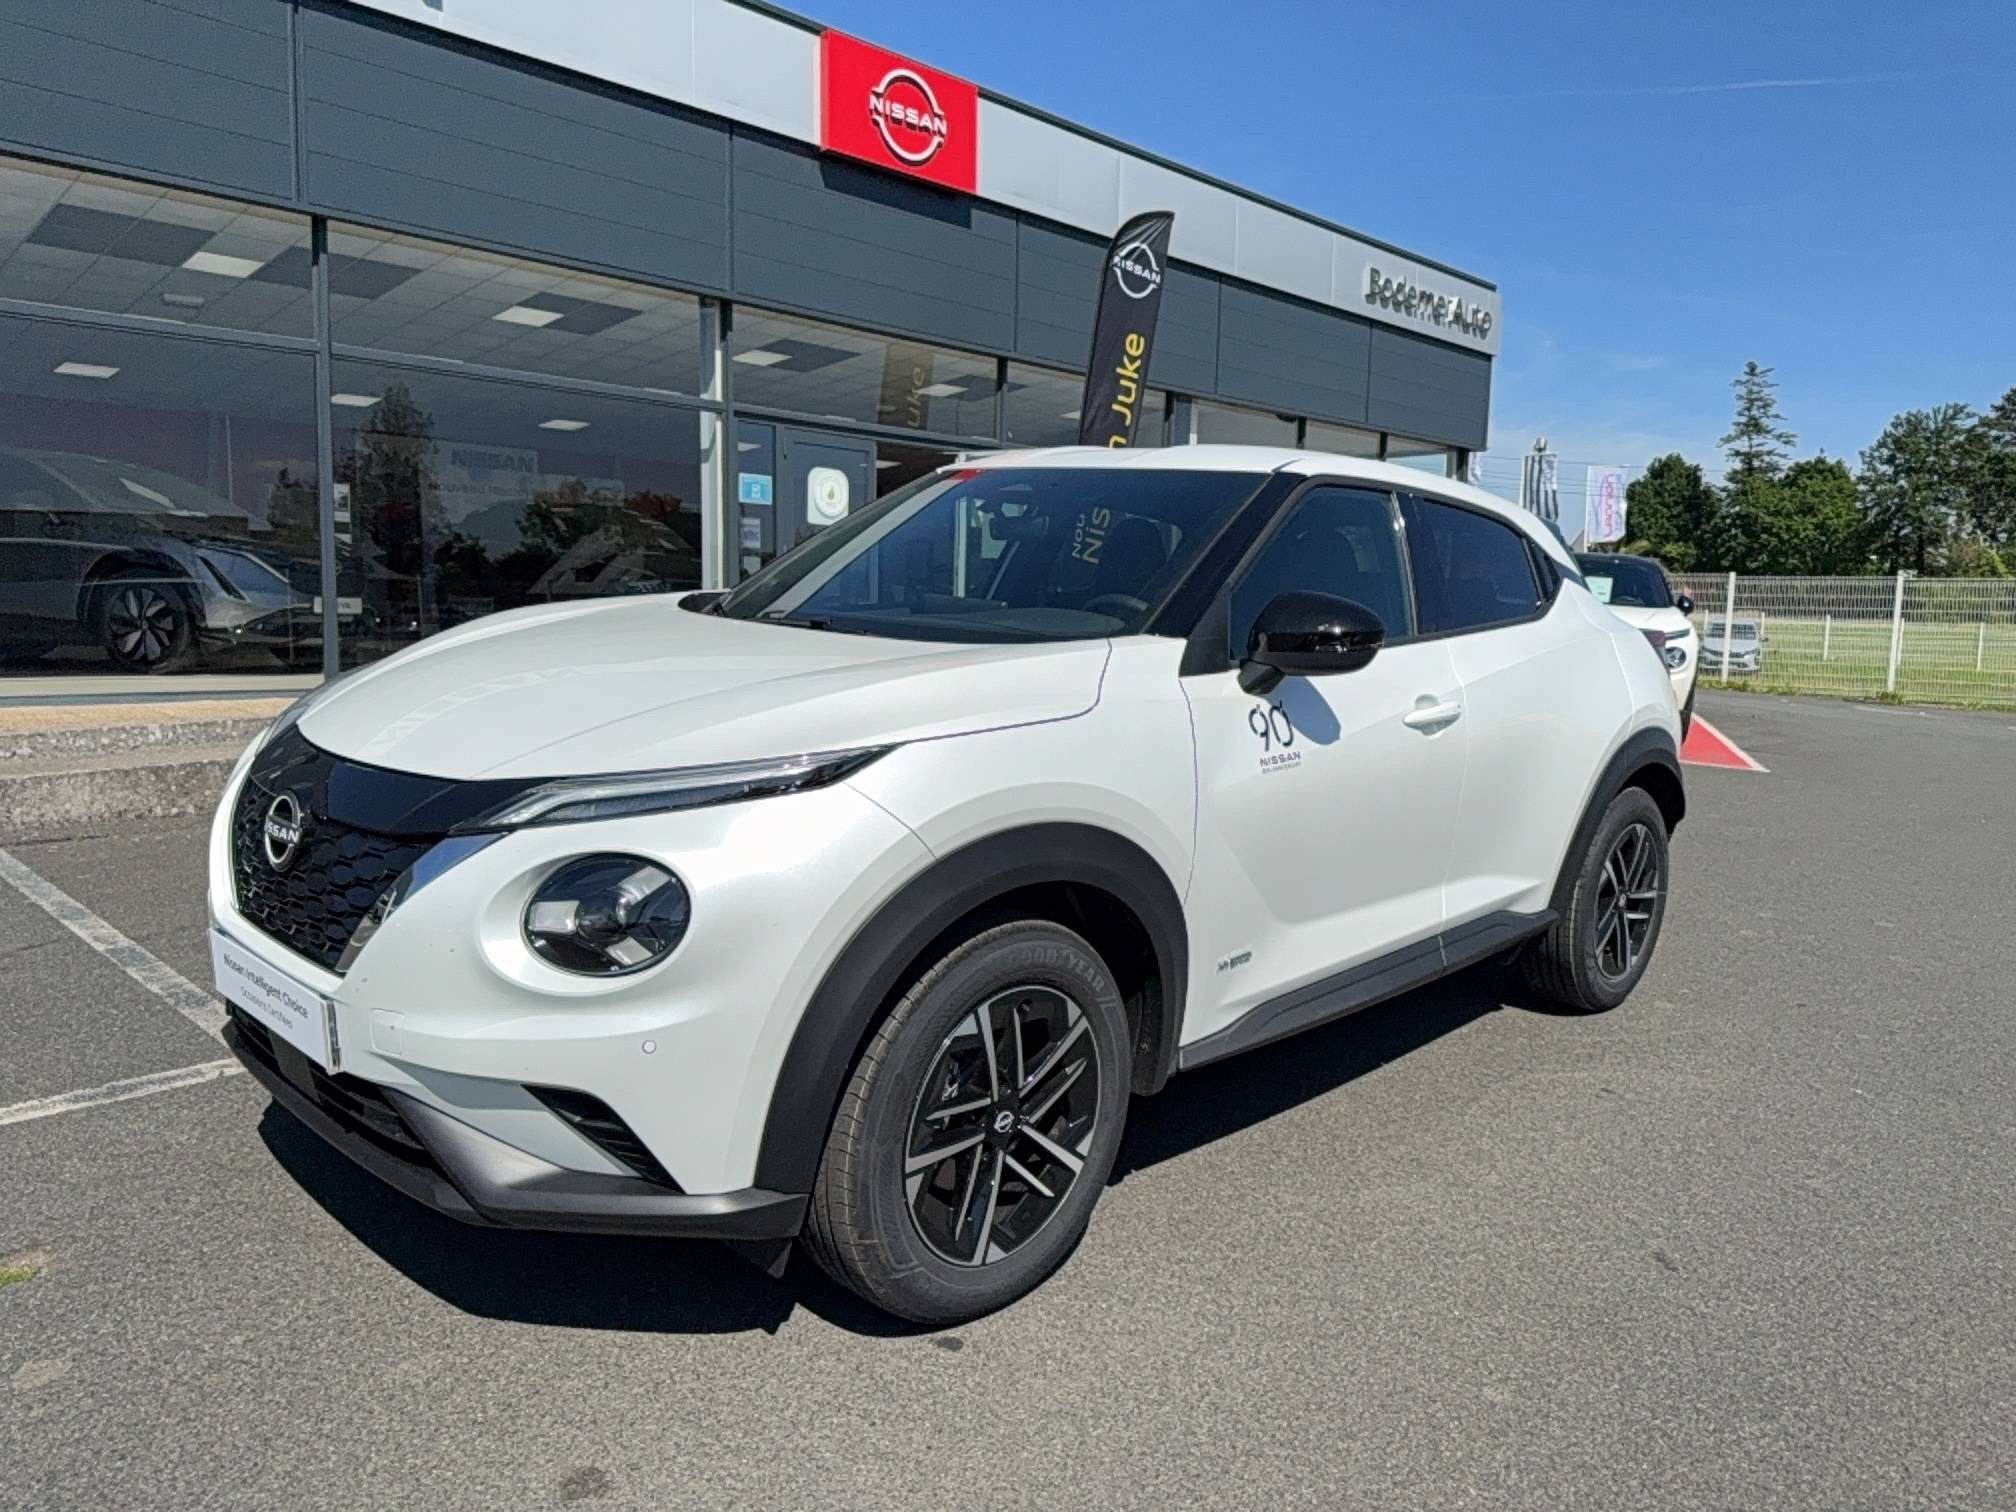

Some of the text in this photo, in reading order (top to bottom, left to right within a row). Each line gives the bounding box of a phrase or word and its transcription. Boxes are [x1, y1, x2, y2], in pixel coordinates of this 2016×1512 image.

[869, 93, 948, 136] NISSAN
[1112, 255, 1162, 284] NISSAN
[1111, 332, 1146, 427] Juke
[1248, 699, 1294, 752] 90
[1259, 751, 1302, 767] NISSAN
[223, 953, 309, 1019] Nissan Intelligent Choice
